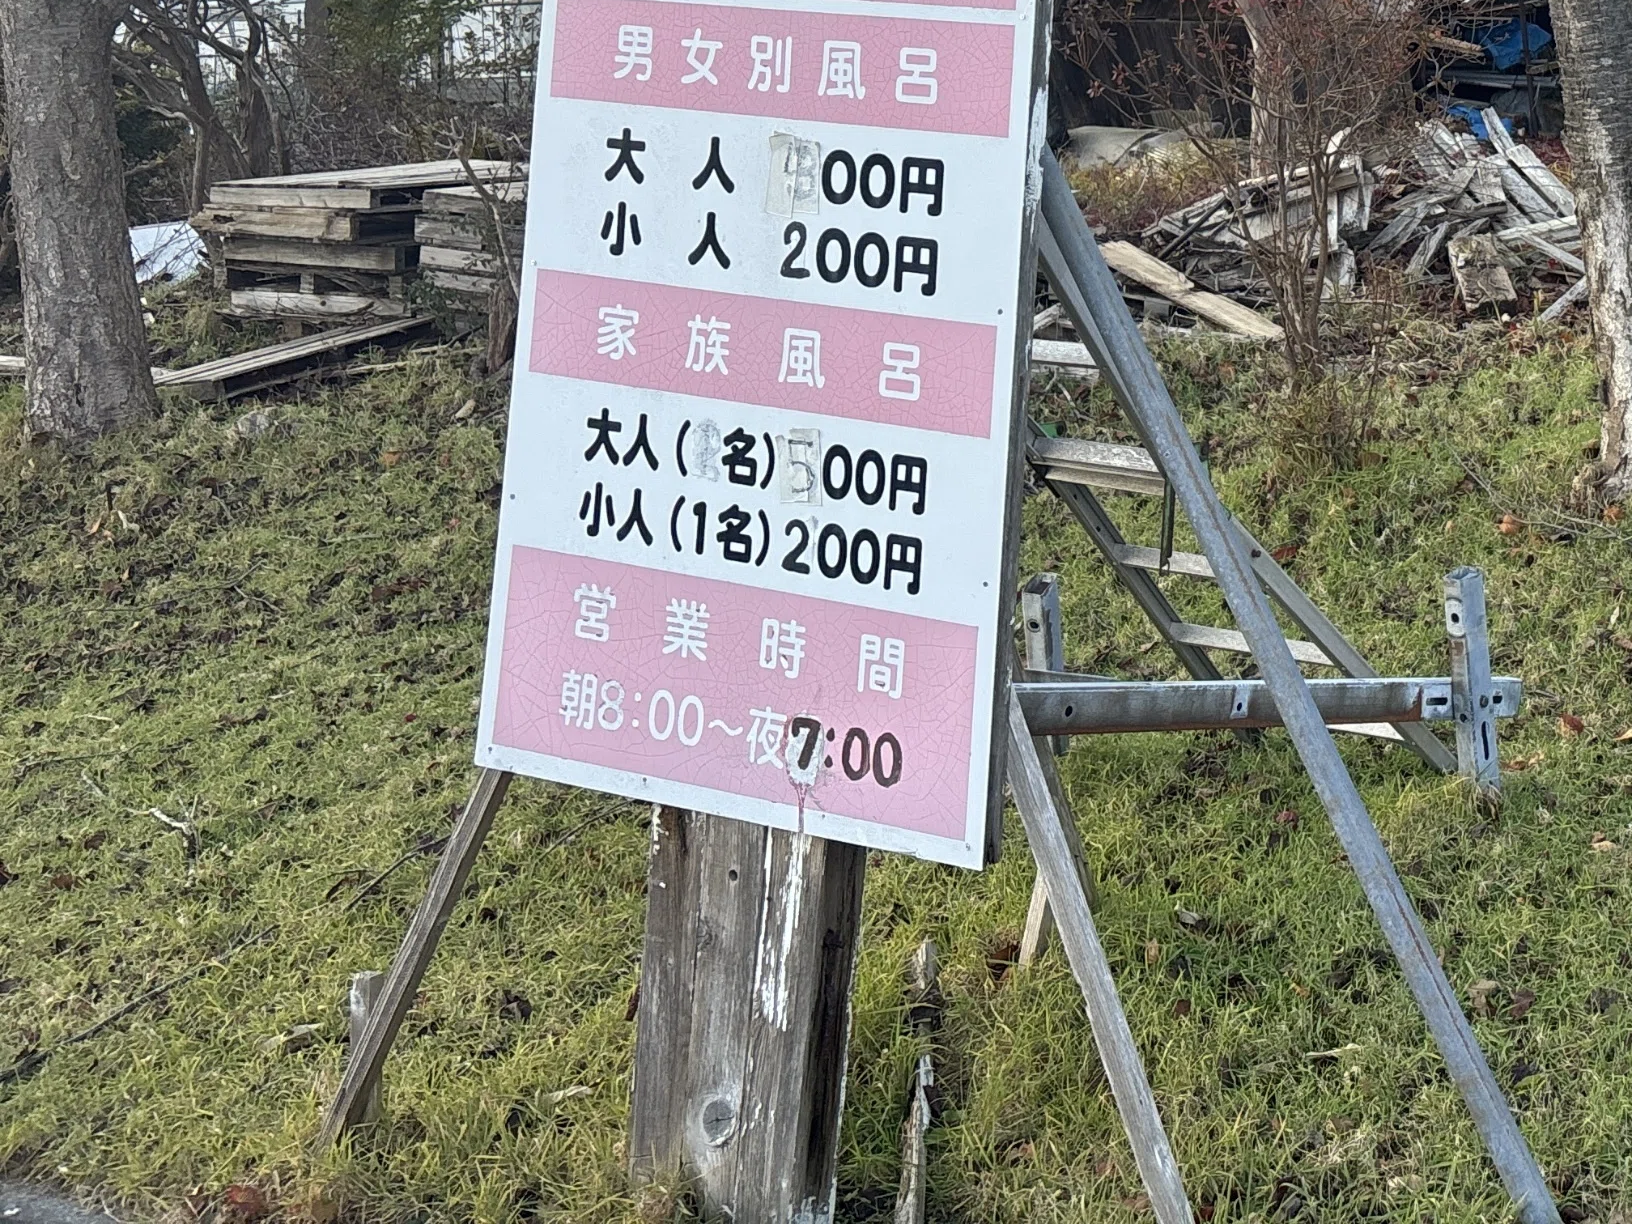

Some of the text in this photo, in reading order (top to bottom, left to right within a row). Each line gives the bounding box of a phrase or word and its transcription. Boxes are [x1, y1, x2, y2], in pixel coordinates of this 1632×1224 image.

[614, 24, 938, 104] 男女別風呂
[780, 221, 938, 297] 200円
[597, 304, 921, 401] 家族風呂
[574, 583, 906, 700] 営業時間
